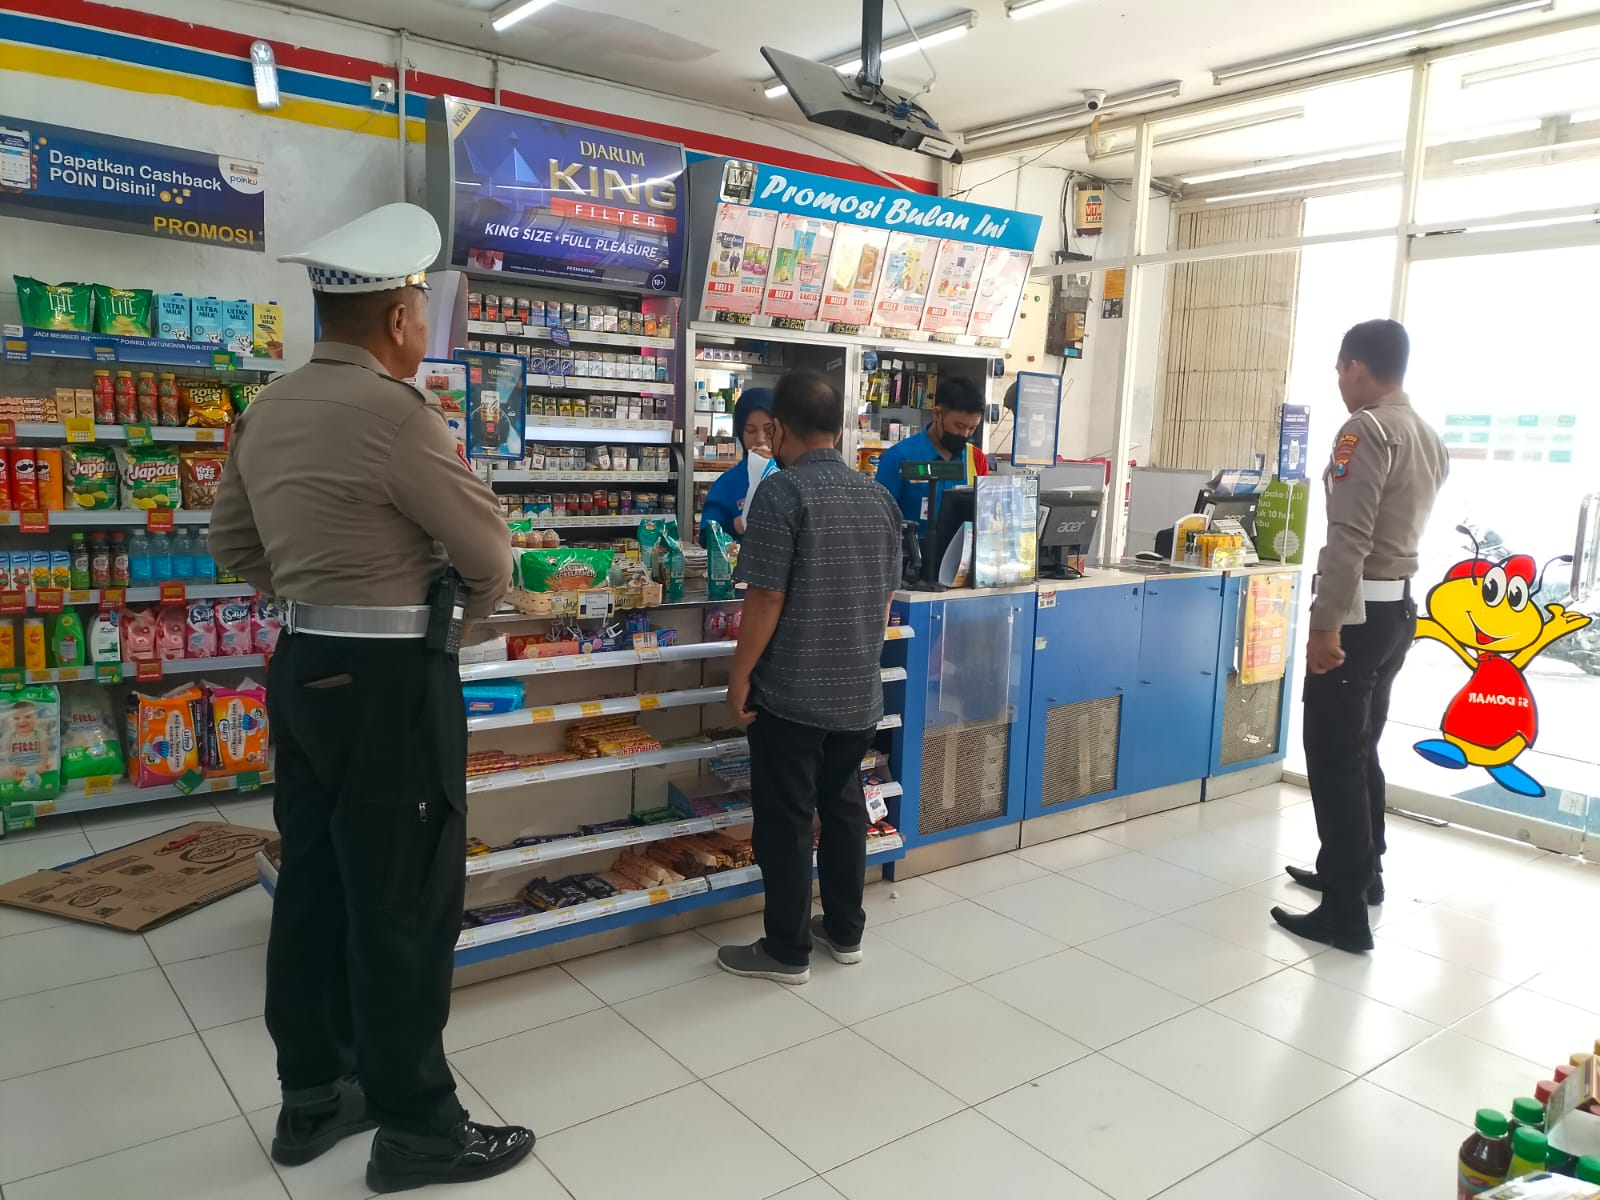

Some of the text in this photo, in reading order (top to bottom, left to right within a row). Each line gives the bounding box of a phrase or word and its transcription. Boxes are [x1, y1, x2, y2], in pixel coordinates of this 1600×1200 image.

[452, 104, 472, 126] NEW
[580, 141, 646, 167] DJARUM
[49, 149, 222, 191] Dapatkan Cashback
[50, 168, 156, 197] POIN Disini!
[549, 158, 677, 210] KING
[575, 205, 657, 227] FILTER
[760, 174, 1010, 240] Promosi Bulan Ini
[153, 216, 254, 245] PROMOSI
[485, 223, 658, 259] KING SIZE FULL PLEASURE
[111, 295, 138, 316] LITE
[162, 302, 185, 310] ULTRA
[196, 305, 218, 313] ULTRA
[226, 308, 248, 316] ULTRA
[129, 463, 178, 482] Japota
[1268, 510, 1278, 518] 10
[1057, 520, 1086, 534] acer
[11, 740, 38, 753] Fitti
